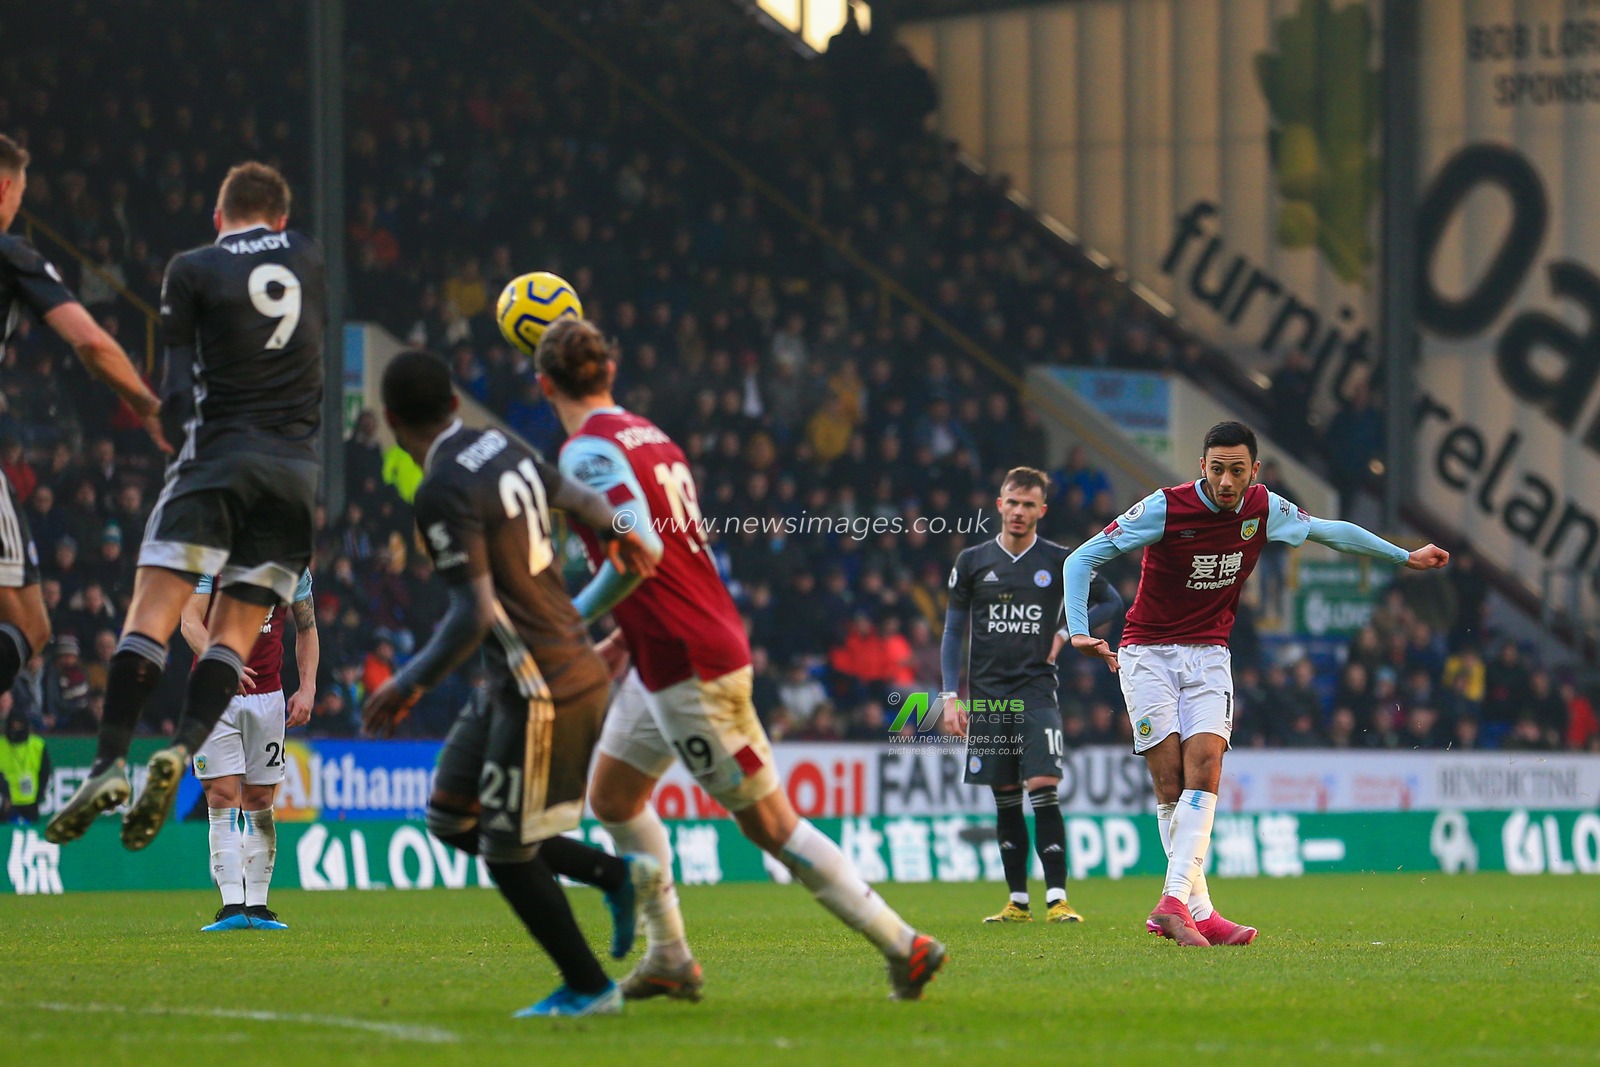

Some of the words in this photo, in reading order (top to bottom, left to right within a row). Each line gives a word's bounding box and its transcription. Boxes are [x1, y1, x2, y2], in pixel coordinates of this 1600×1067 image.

[221, 231, 291, 255] VARDY
[247, 263, 302, 350] 9
[499, 457, 554, 577] 21
[1189, 551, 1243, 580] 爱博
[1185, 576, 1237, 591] LoveBet
[987, 621, 1041, 635] POWER
[988, 604, 1043, 621] KING
[673, 735, 712, 772] 19
[1044, 728, 1063, 757] 10
[275, 753, 436, 811] Altham
[479, 760, 522, 813] 21
[787, 761, 865, 817] Oil
